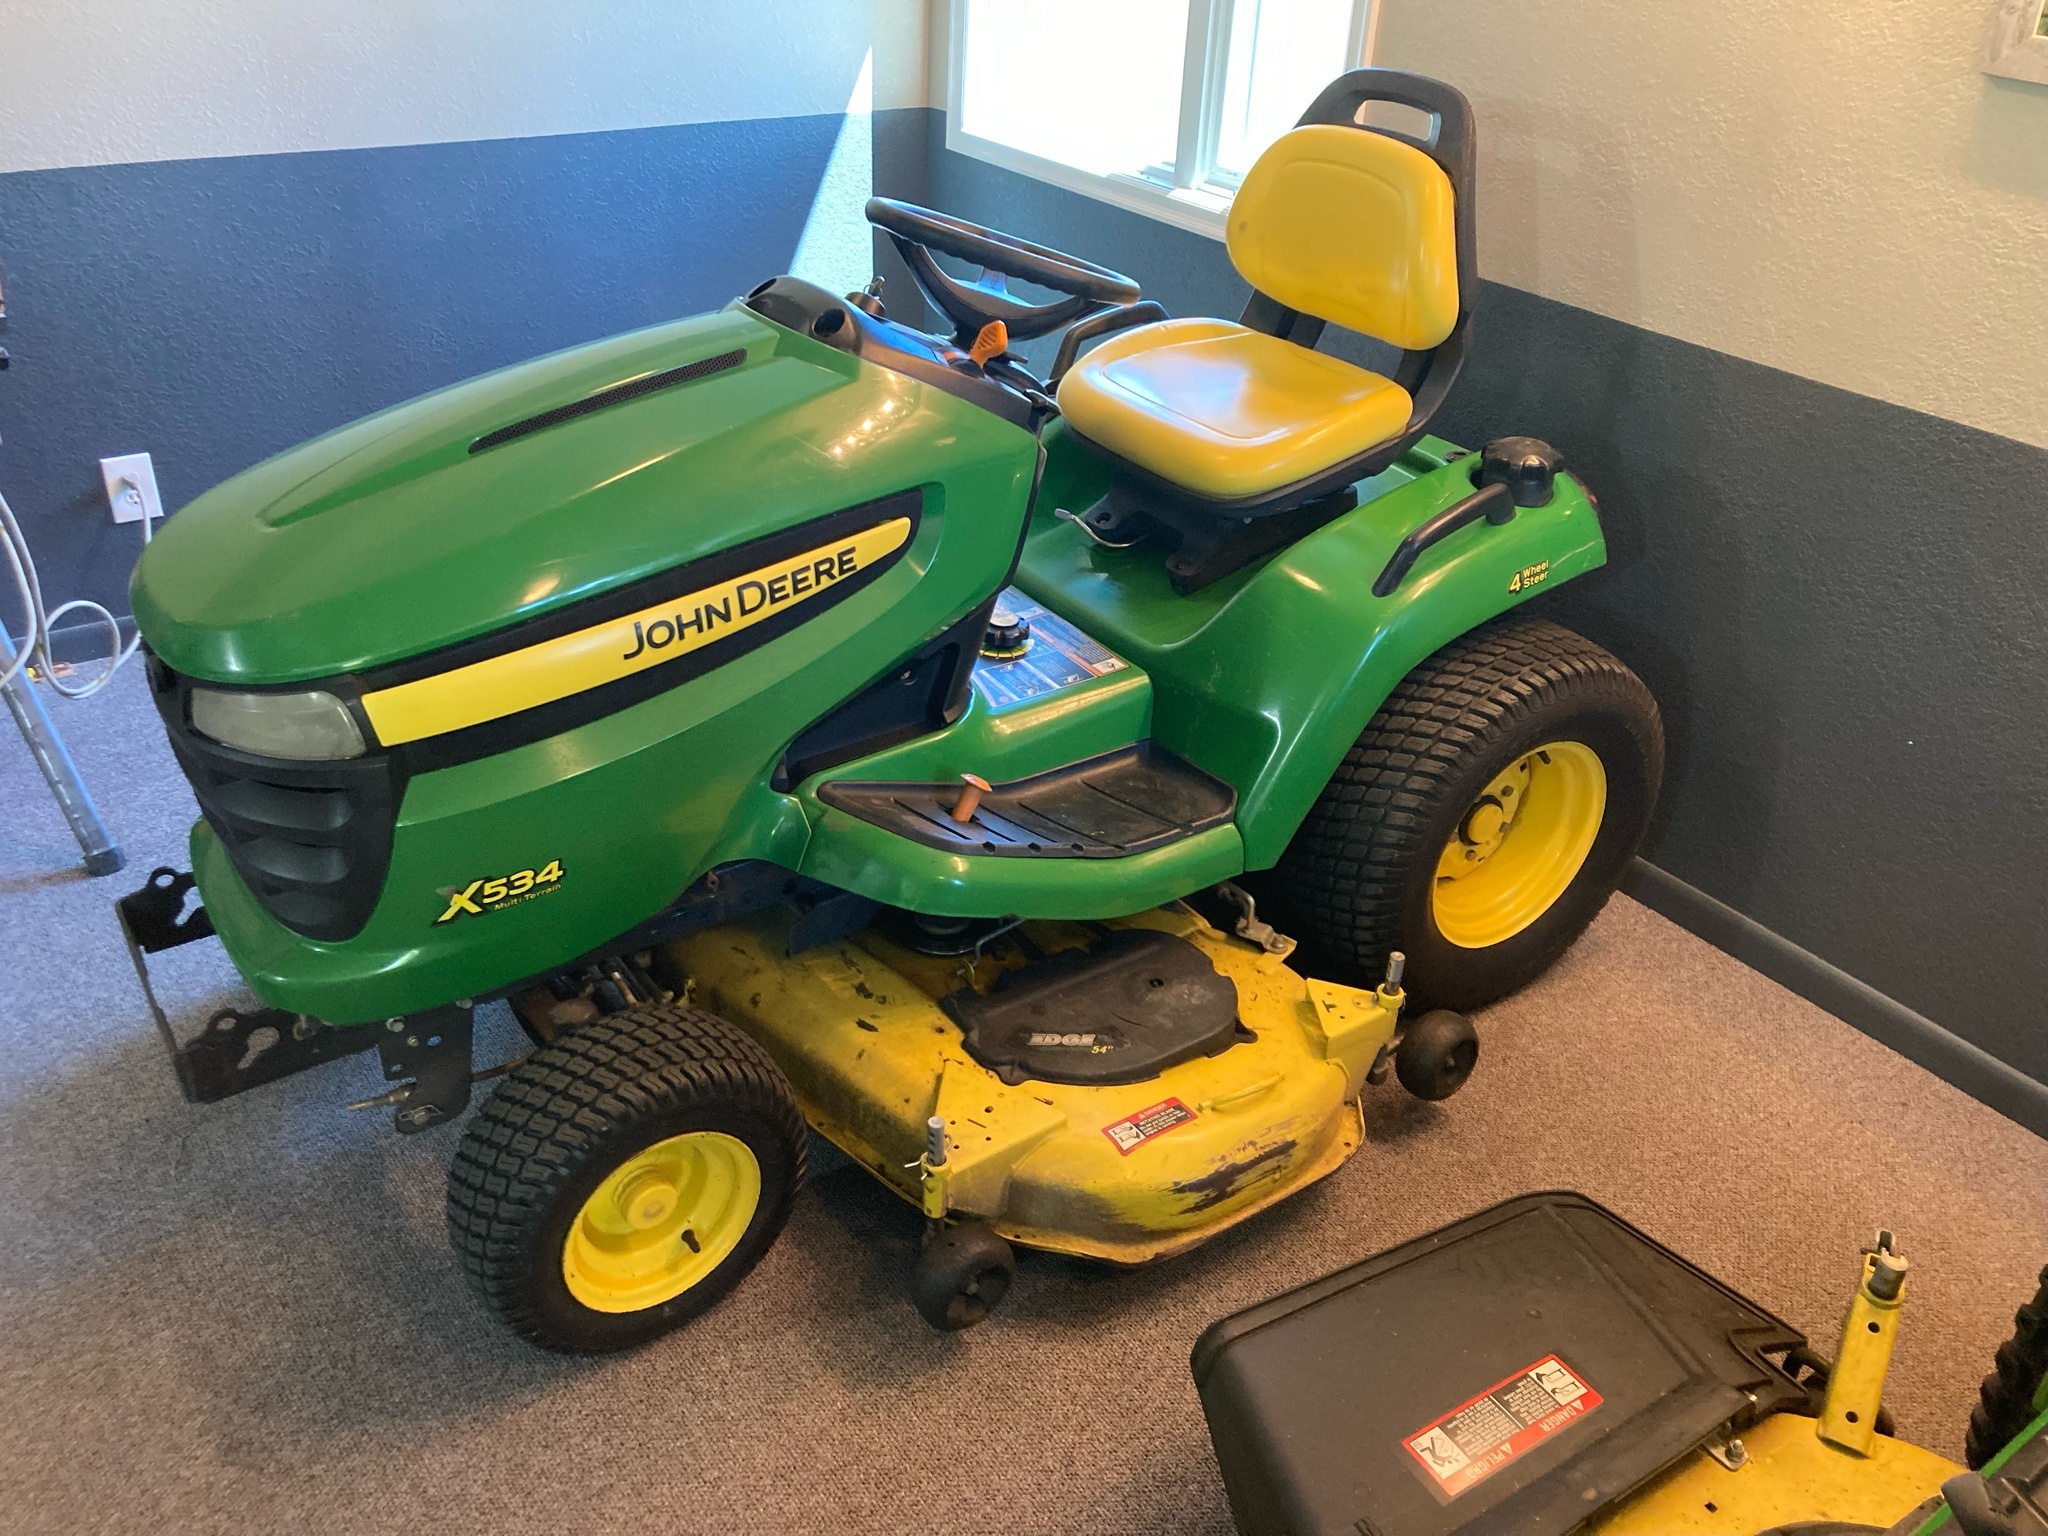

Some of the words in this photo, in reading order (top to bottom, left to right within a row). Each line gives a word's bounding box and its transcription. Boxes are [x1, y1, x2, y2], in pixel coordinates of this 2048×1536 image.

[1509, 573, 1522, 592] 4
[1523, 559, 1549, 578] Wheel
[1523, 571, 1549, 588] Steer
[623, 597, 732, 660] JOHN
[736, 546, 858, 617] DEERE
[436, 859, 564, 922] X534
[494, 884, 562, 911] Multi-Terrain
[1026, 1033, 1097, 1047] EDGE
[1539, 1407, 1578, 1432] DANGER
[1466, 1449, 1506, 1479] PELIGRO
